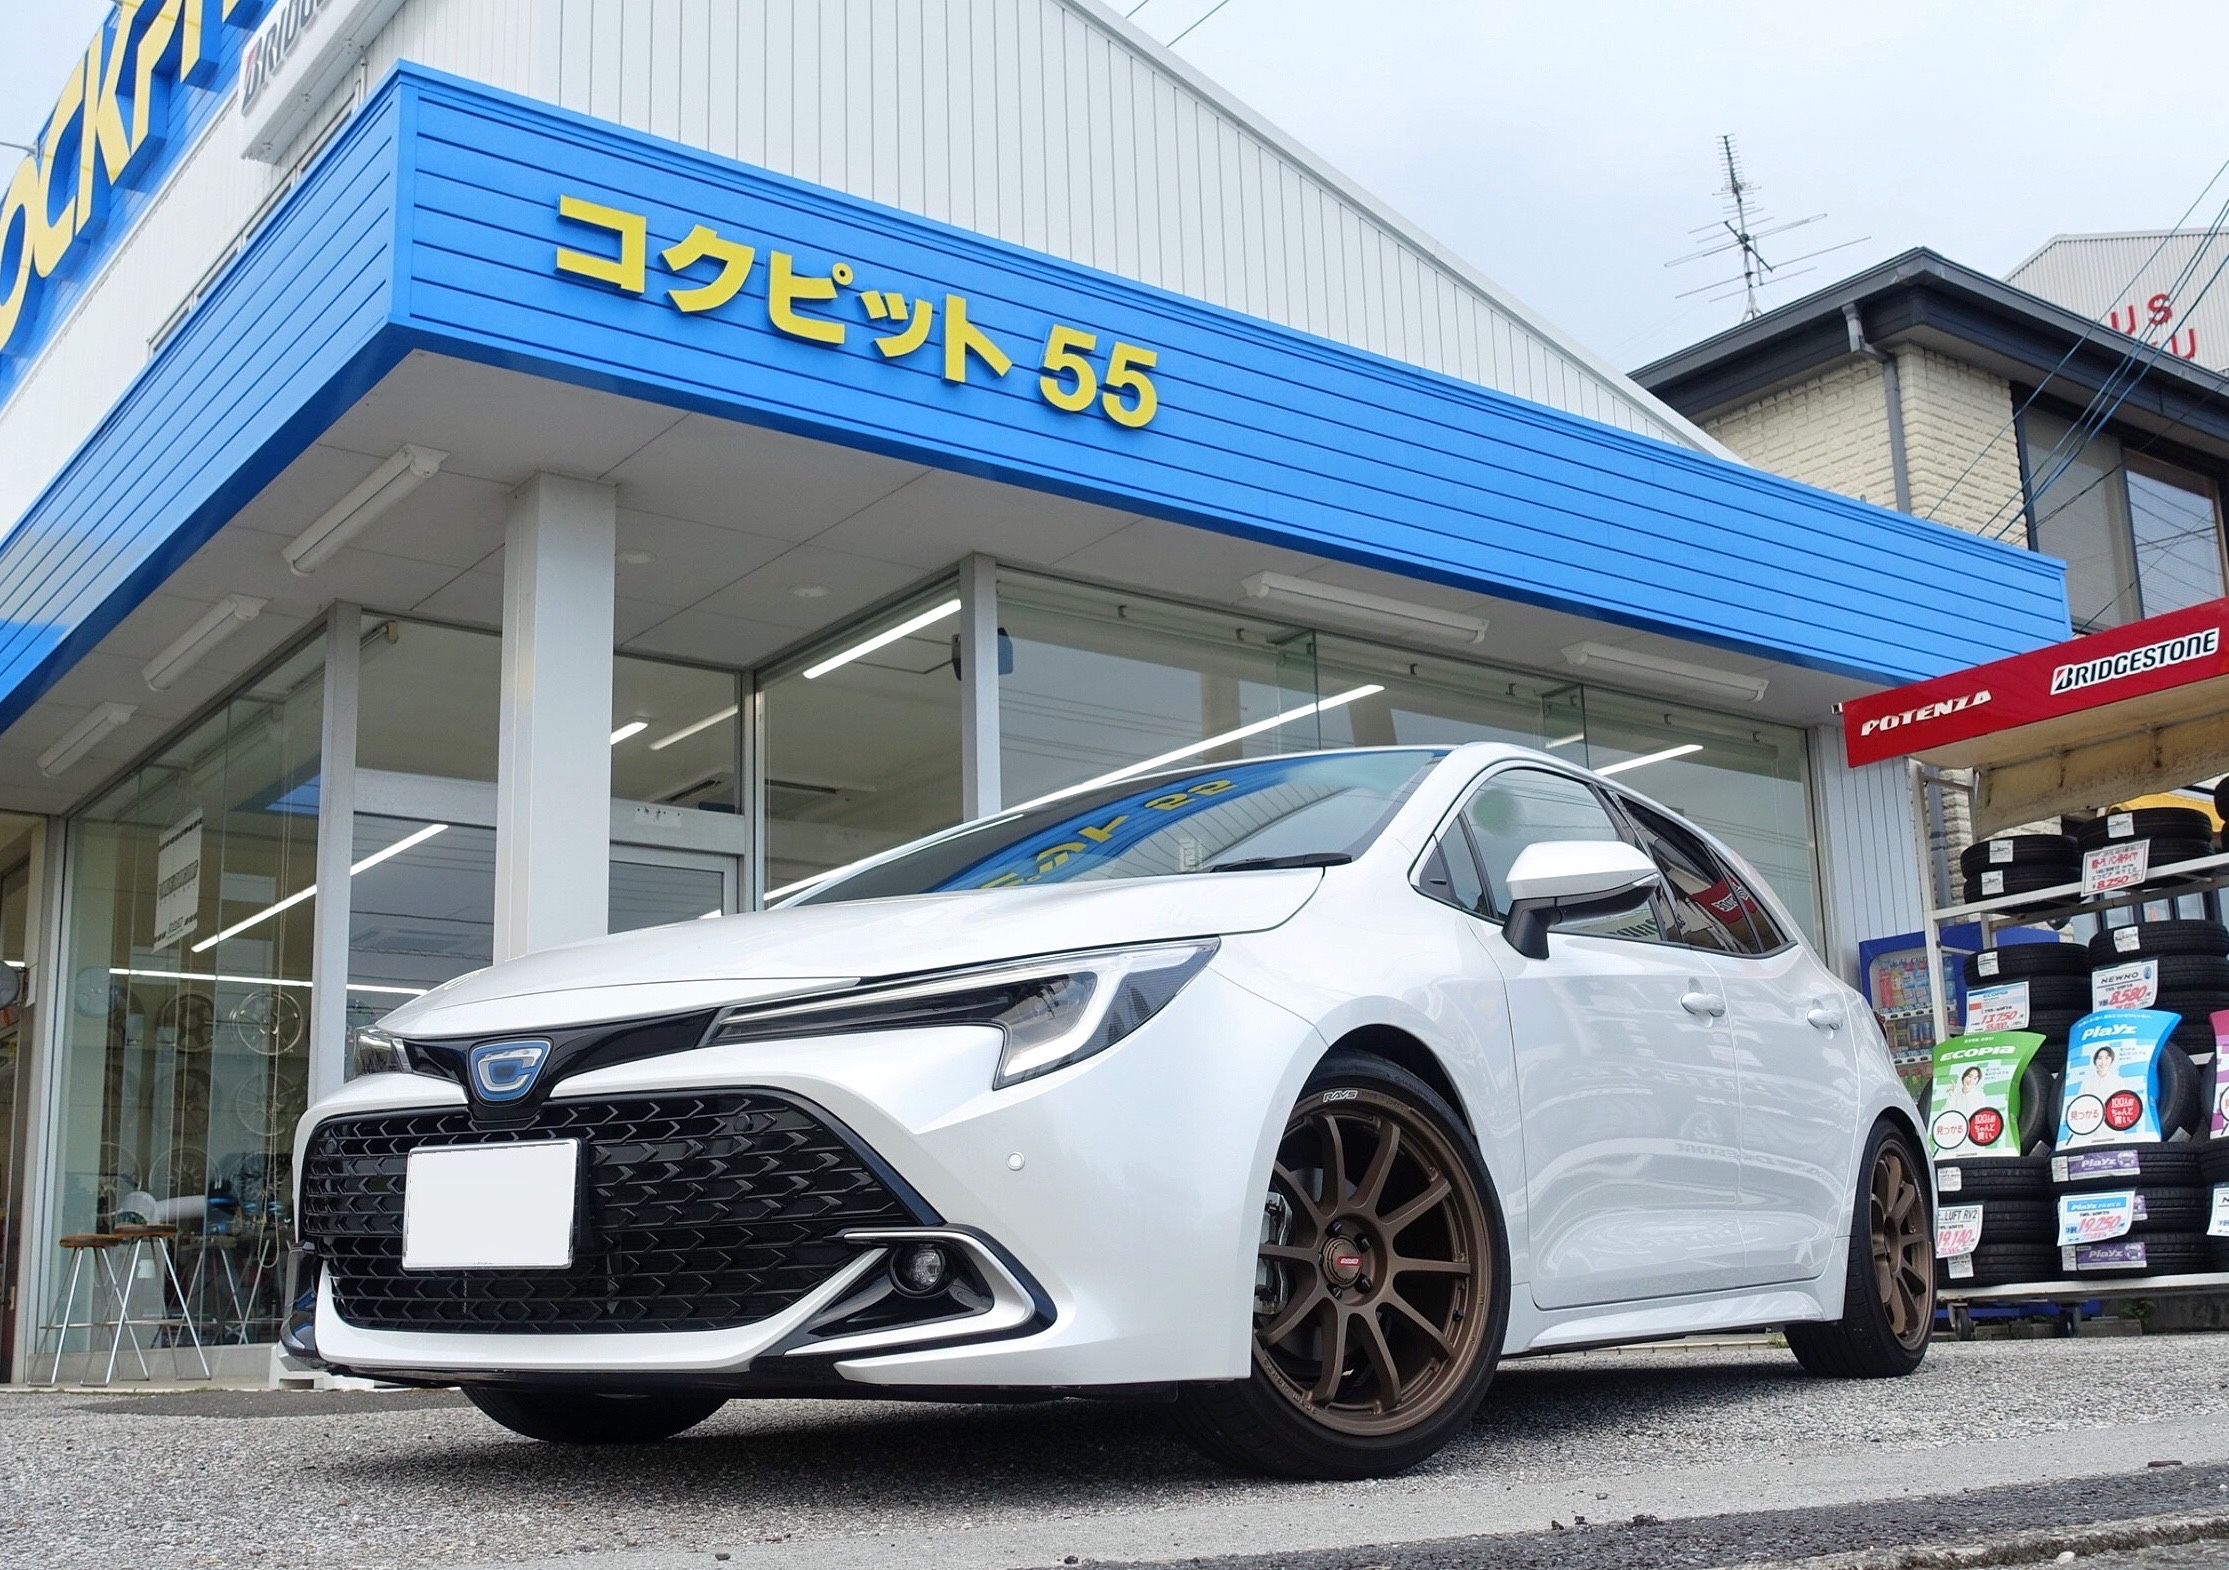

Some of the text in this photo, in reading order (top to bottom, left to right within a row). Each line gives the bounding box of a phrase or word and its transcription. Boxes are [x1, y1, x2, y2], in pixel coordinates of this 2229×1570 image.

[555, 194, 1159, 430] コクピット 55
[1860, 629, 2219, 736] POTENZA BRIDGESTONE
[2101, 971, 2139, 984] NEWNO
[1323, 1089, 1358, 1102] RAYS
[2070, 1109, 2100, 1121] 見つかる
[1936, 1125, 1964, 1136] 見つかる
[1944, 1209, 1962, 1221] LUFT
